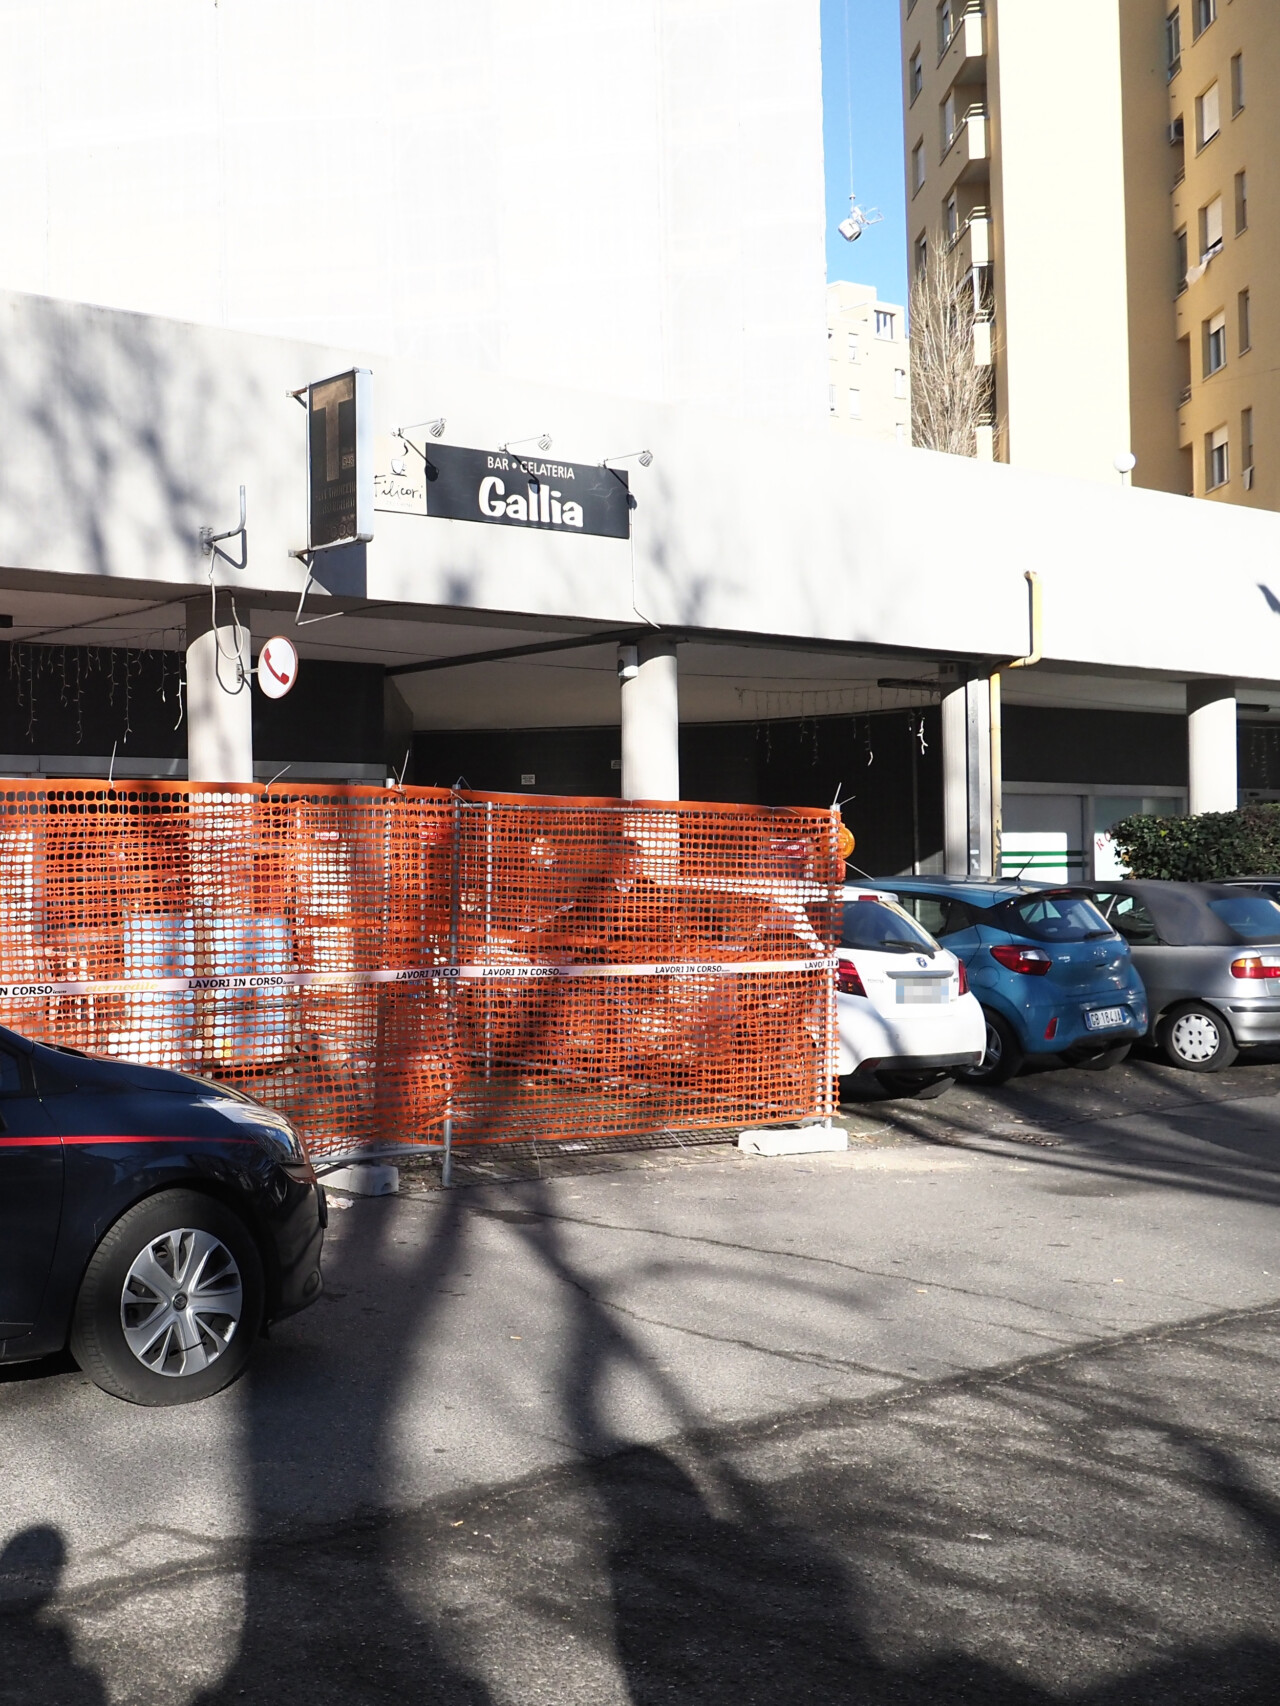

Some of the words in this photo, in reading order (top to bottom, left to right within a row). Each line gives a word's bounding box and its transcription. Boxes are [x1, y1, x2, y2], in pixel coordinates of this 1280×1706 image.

[487, 456, 509, 470] BAR
[520, 461, 575, 479] GELATERIA
[478, 476, 584, 528] Gallia
[396, 970, 430, 980] LAVORI
[431, 969, 441, 977] IN
[482, 968, 517, 976] LAVORI
[517, 968, 528, 976] IN
[530, 968, 560, 976] CORSO
[655, 966, 685, 974] LAVORI
[686, 966, 695, 974] IN
[696, 965, 722, 973] CORSO
[188, 979, 231, 989] LAVORI
[233, 979, 247, 987] IN
[249, 977, 283, 986] CORSO
[11, 985, 53, 996] CORSO
